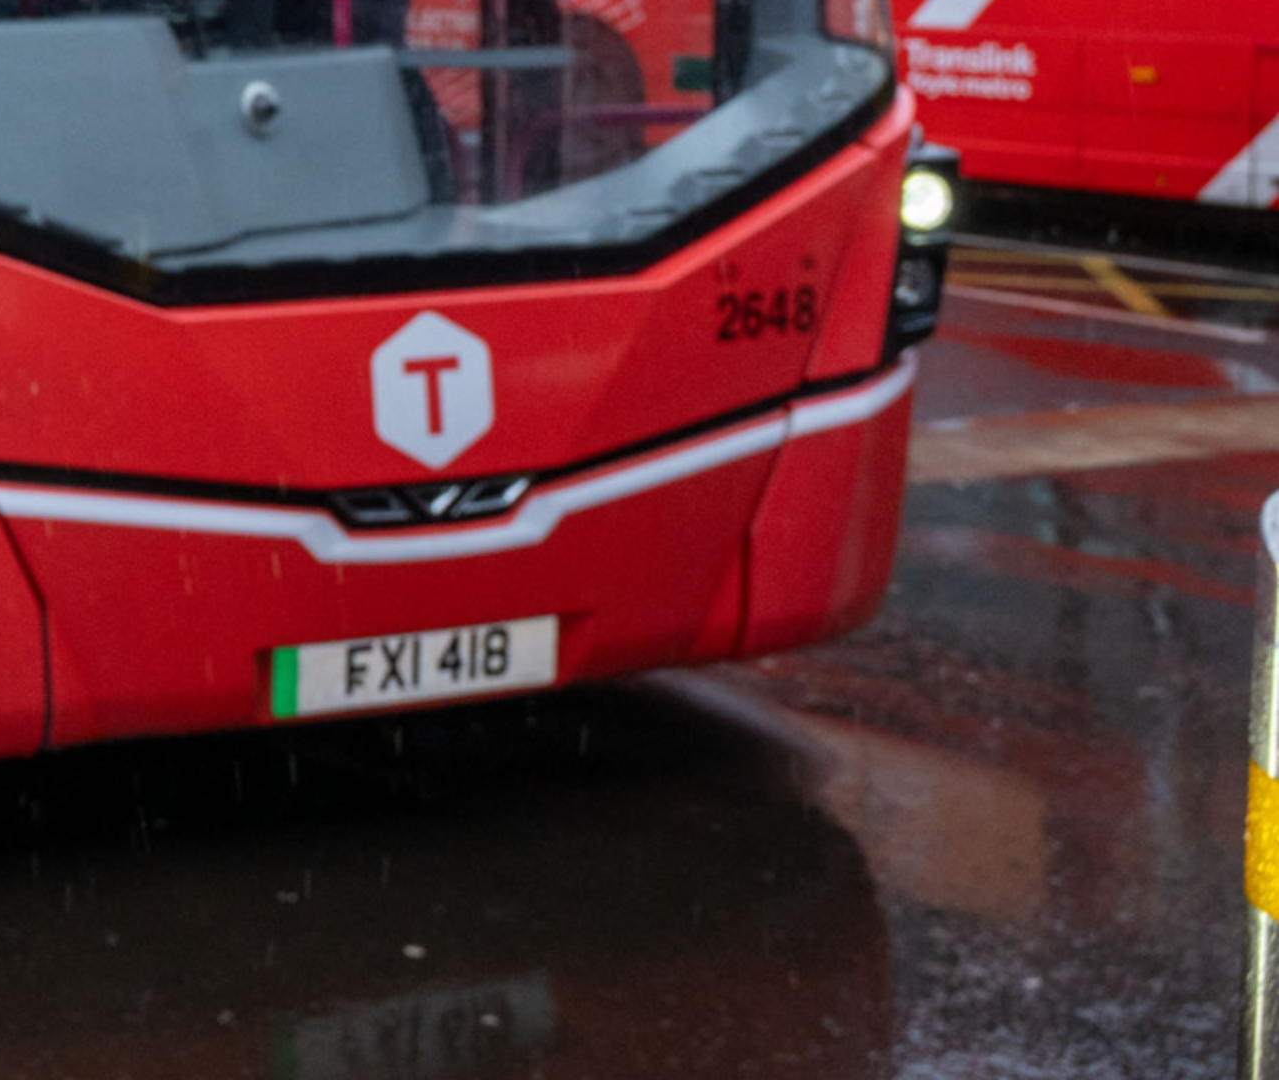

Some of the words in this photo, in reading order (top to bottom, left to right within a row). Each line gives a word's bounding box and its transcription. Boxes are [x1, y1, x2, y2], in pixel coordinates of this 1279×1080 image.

[903, 37, 1038, 78] Translink
[716, 284, 818, 342] 2648
[403, 356, 459, 435] T
[345, 633, 421, 696] FXI
[436, 616, 510, 685] 418
